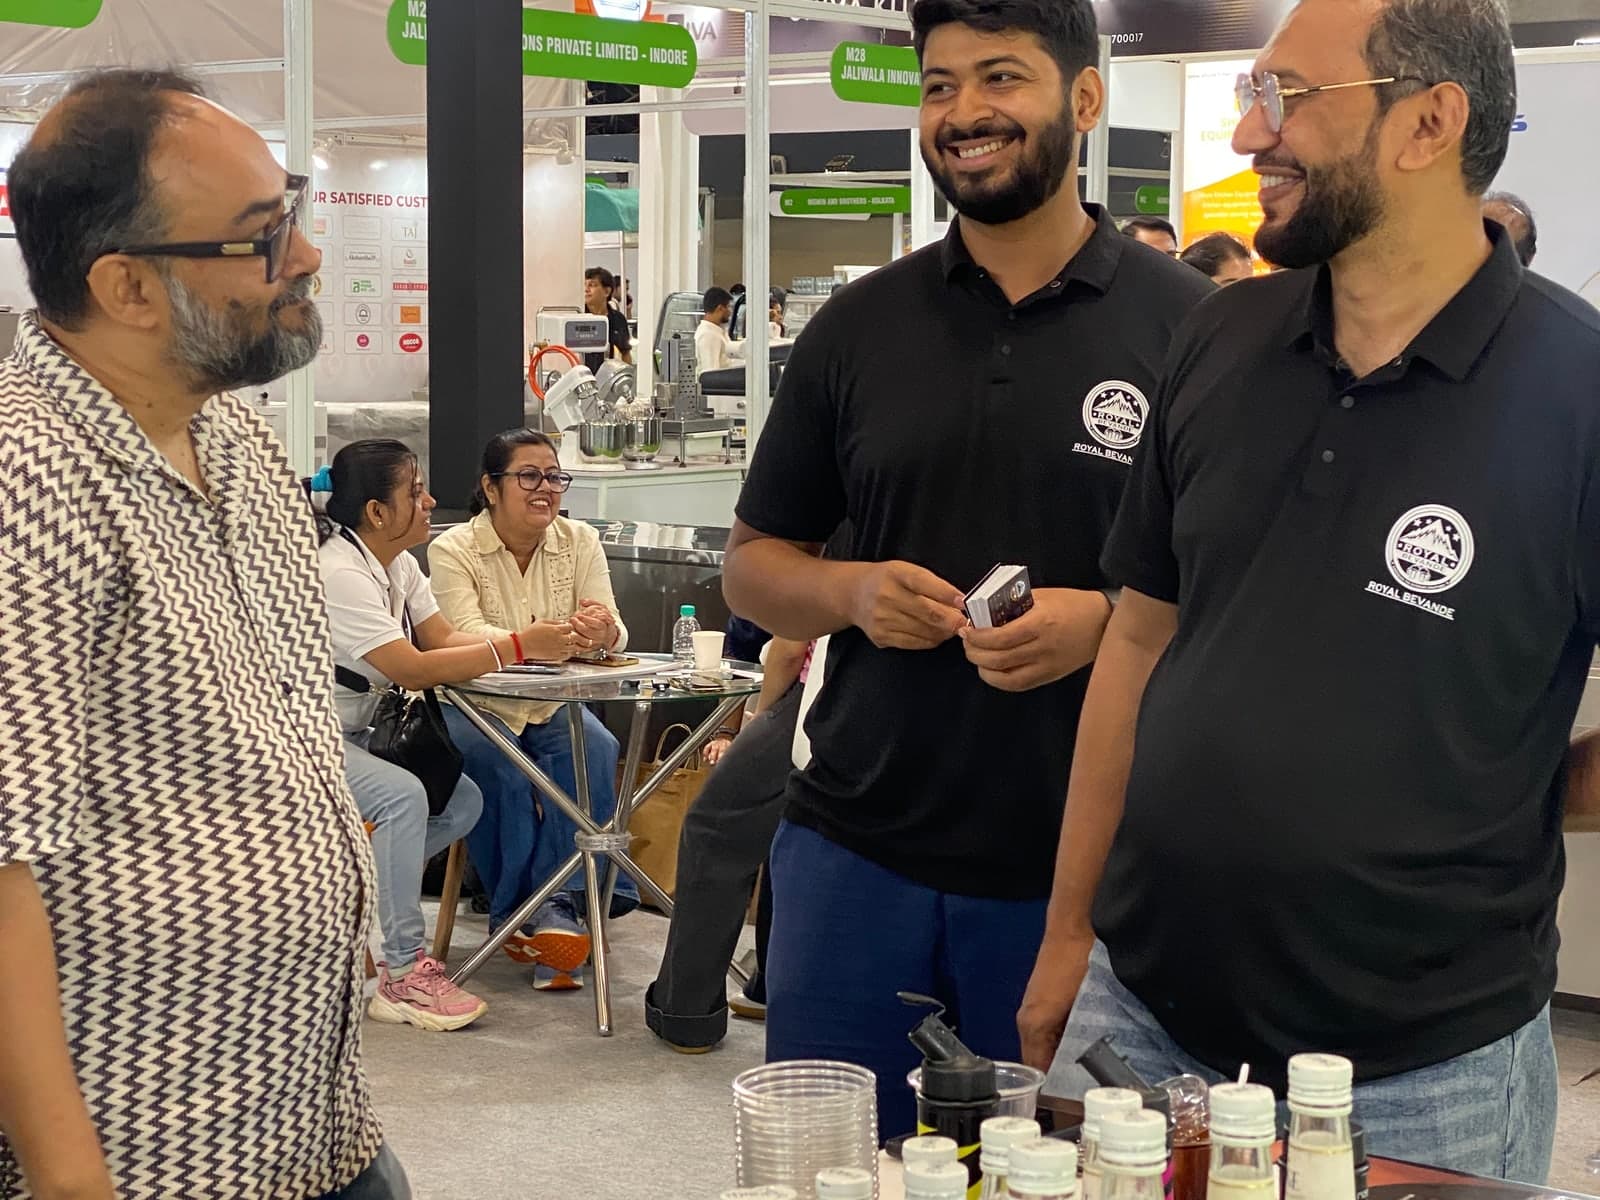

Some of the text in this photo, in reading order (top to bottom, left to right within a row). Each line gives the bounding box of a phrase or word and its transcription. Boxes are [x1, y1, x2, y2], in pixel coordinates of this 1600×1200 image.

[1111, 32, 1144, 44] 700017
[546, 36, 592, 56] PRIVATE
[596, 41, 639, 61] LIMITED
[649, 47, 688, 65] INDORE
[846, 47, 866, 62] M28
[841, 65, 885, 83] JALIWALA
[330, 191, 393, 206] SATISFIED
[1098, 412, 1134, 427] ROYAL
[1073, 442, 1103, 455] ROYAL
[1403, 544, 1449, 567] ROYAL
[1367, 581, 1455, 618] ROYAL BEVANDE
